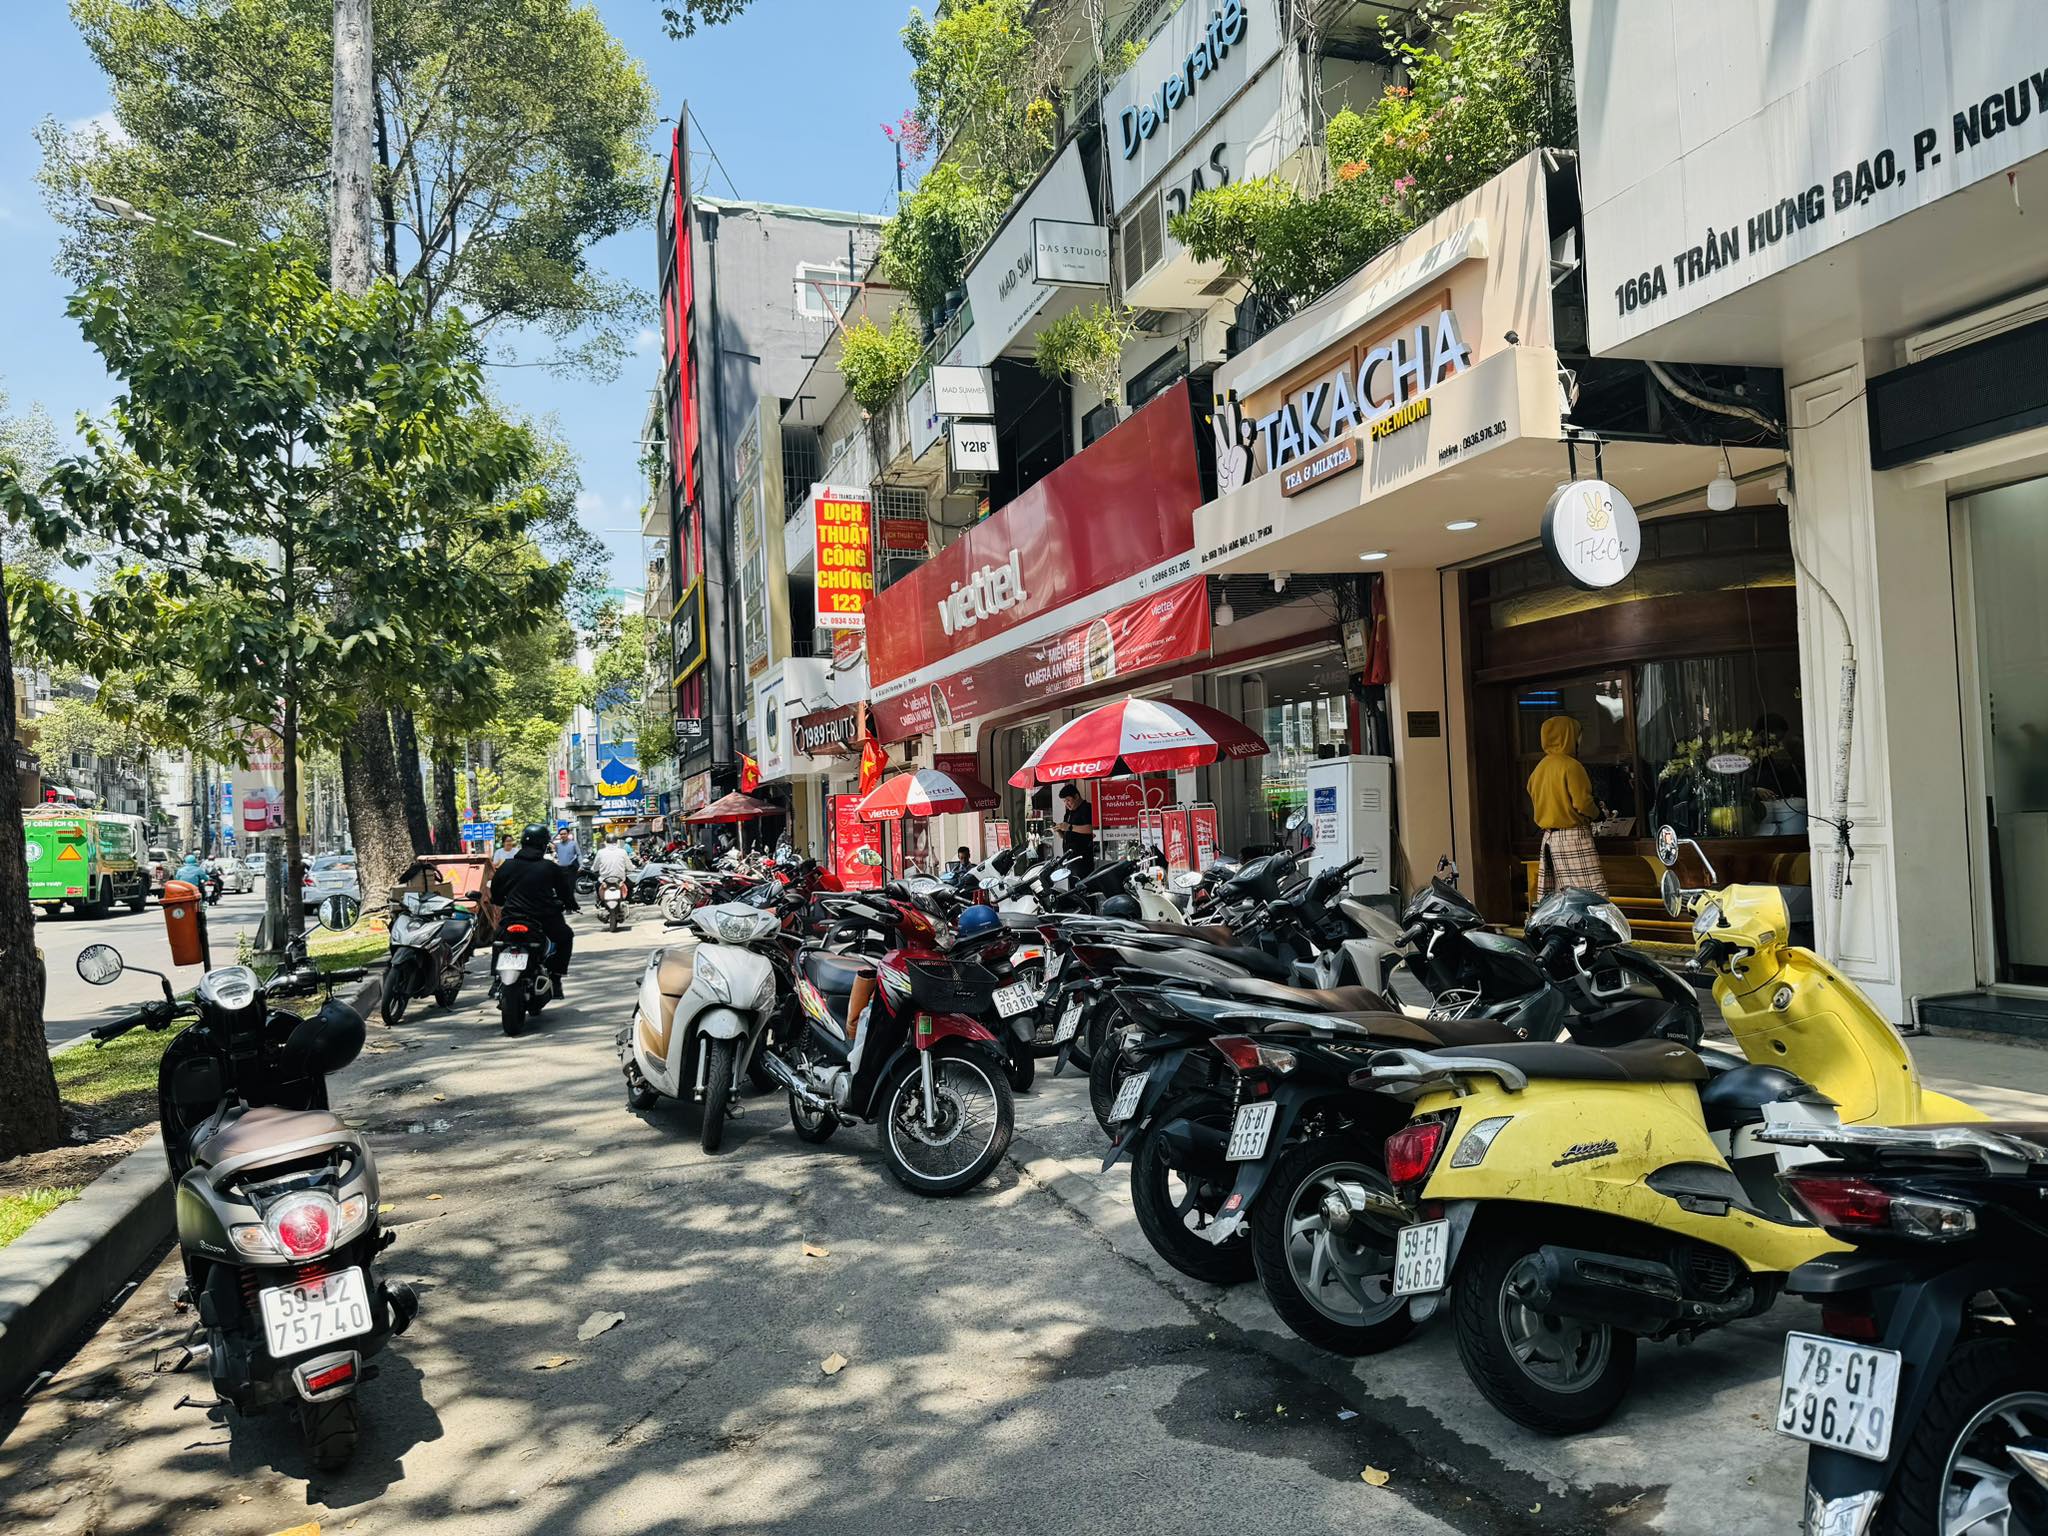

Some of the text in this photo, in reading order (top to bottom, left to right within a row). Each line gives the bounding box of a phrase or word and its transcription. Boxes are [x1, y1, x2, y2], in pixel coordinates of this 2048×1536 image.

[1615, 265, 1668, 317] 166A
[1673, 227, 1740, 289] TRẦN
[1748, 183, 1825, 254] HƯNG
[1832, 148, 1906, 213] ĐẠO,
[1914, 127, 1941, 173] P.
[1039, 243, 1108, 257] DAS STUDIOS
[997, 269, 1016, 303] MAD
[942, 386, 985, 394] MAD SUMMER
[1257, 310, 1471, 473] TAKACHA
[1371, 397, 1431, 442] PREMIUM
[1285, 446, 1351, 490] TEA & MILKTEA
[823, 502, 863, 525] DỊCH
[818, 523, 869, 548] THUẬT
[822, 545, 867, 567] CÔNG
[818, 568, 873, 590] CHỨNG
[831, 594, 861, 612] 123
[937, 548, 1027, 636] viettel
[1151, 600, 1175, 617] viettel
[1025, 664, 1052, 687] CAMERA
[1052, 662, 1062, 680] AN
[804, 715, 856, 748] 1989 FRUITS
[1129, 728, 1196, 741] viettel
[1228, 741, 1264, 755] viettel
[1049, 760, 1101, 777] viettel
[868, 808, 900, 818] viettel
[974, 799, 997, 808] viettel
[997, 984, 1026, 1003] 59-L3
[1001, 995, 1034, 1017] 283.88
[1239, 1107, 1268, 1131] 76-B1
[1231, 1132, 1265, 1156] 515.51
[1404, 1230, 1439, 1260] 59-E1
[1397, 1256, 1442, 1291] 946.62
[279, 1275, 349, 1318] 59-L2
[275, 1302, 365, 1351] 757.40
[1799, 1341, 1880, 1399] 78-G1
[1782, 1386, 1885, 1451] 596.79
